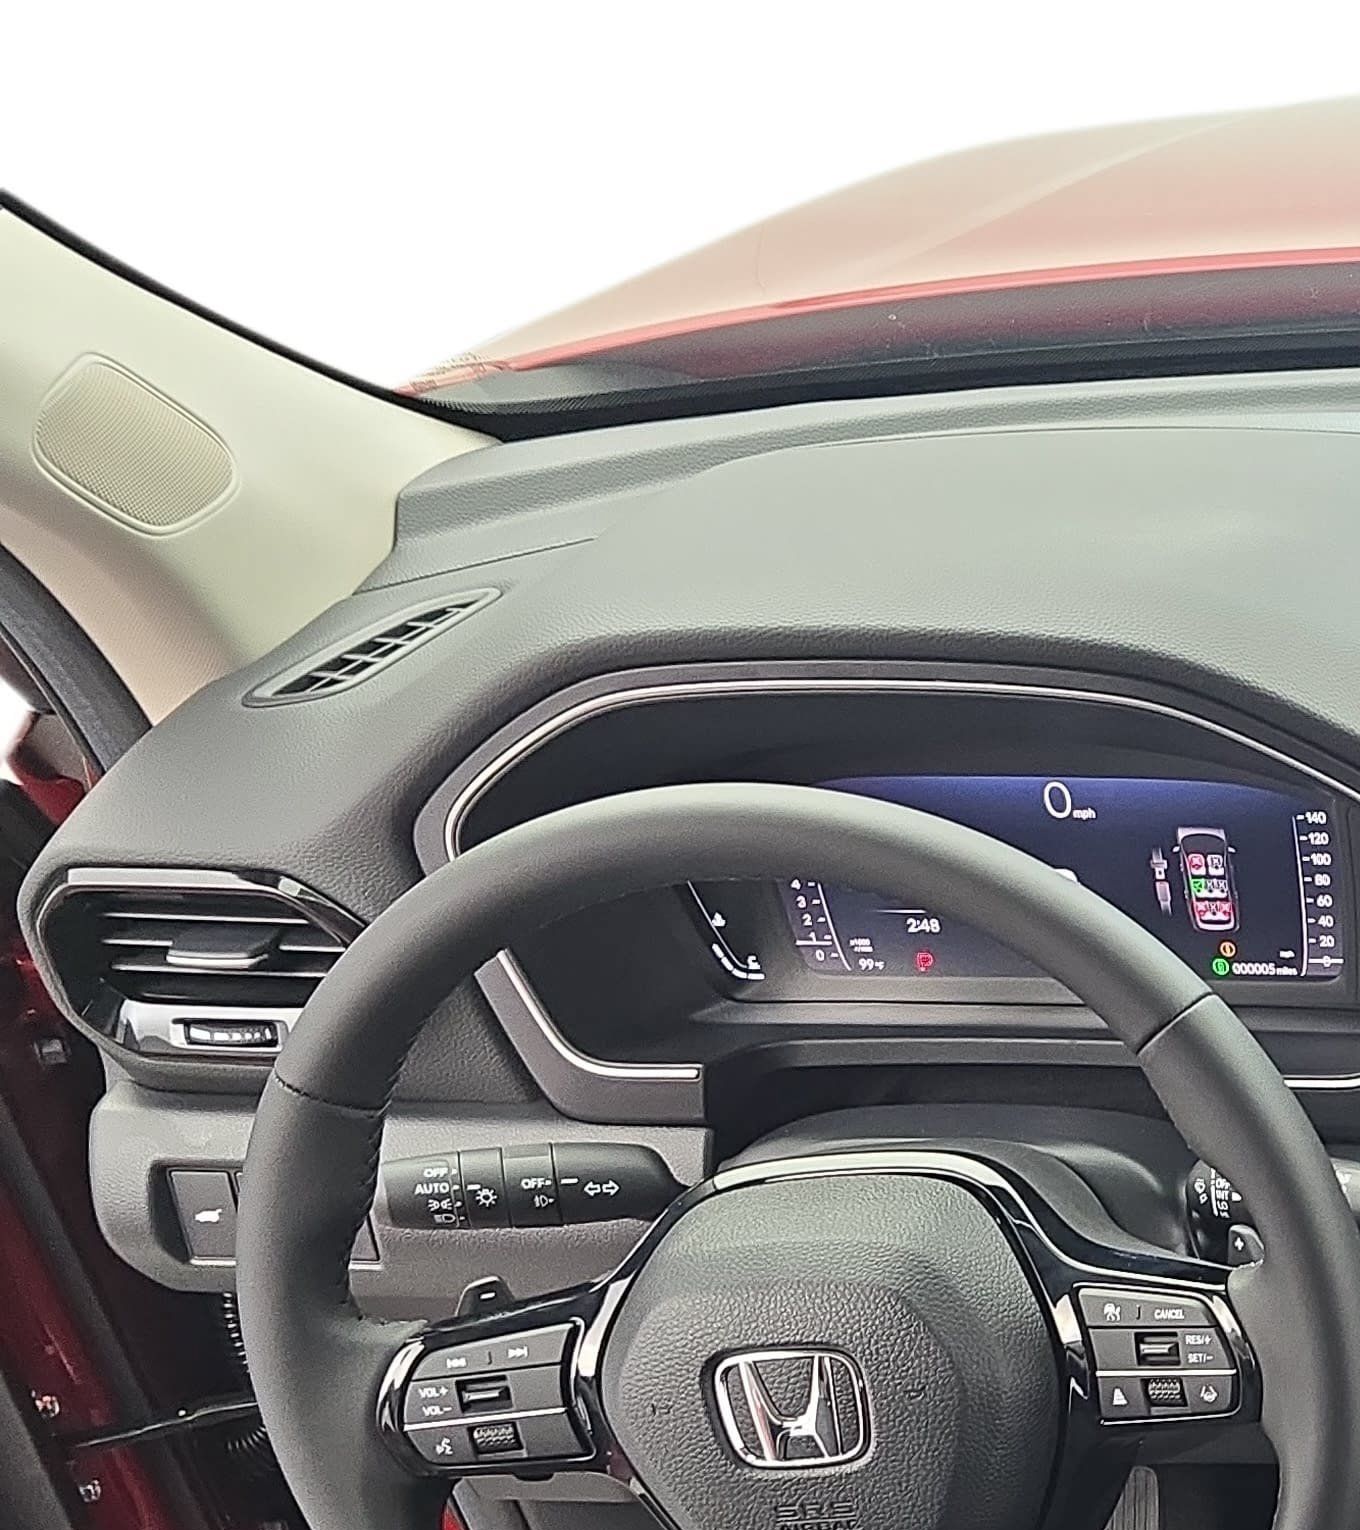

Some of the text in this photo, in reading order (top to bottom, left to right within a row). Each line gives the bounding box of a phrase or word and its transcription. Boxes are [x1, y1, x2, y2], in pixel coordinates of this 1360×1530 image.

[1043, 781, 1096, 820] 0 mph
[1305, 811, 1327, 824] 140
[1308, 832, 1329, 845] 120
[1311, 853, 1332, 866] 100
[1316, 895, 1333, 907] 60
[802, 914, 813, 926] 2
[906, 918, 940, 934] 2:48
[1318, 915, 1334, 928] 40
[1319, 935, 1335, 948] 20
[815, 950, 824, 960] 0
[1232, 963, 1275, 975] 000005
[424, 1168, 448, 1178] OFF
[415, 1183, 449, 1194] AUTO
[522, 1178, 545, 1189] OFF
[1154, 1309, 1184, 1320] CANCEL
[419, 1386, 448, 1398] VOL+
